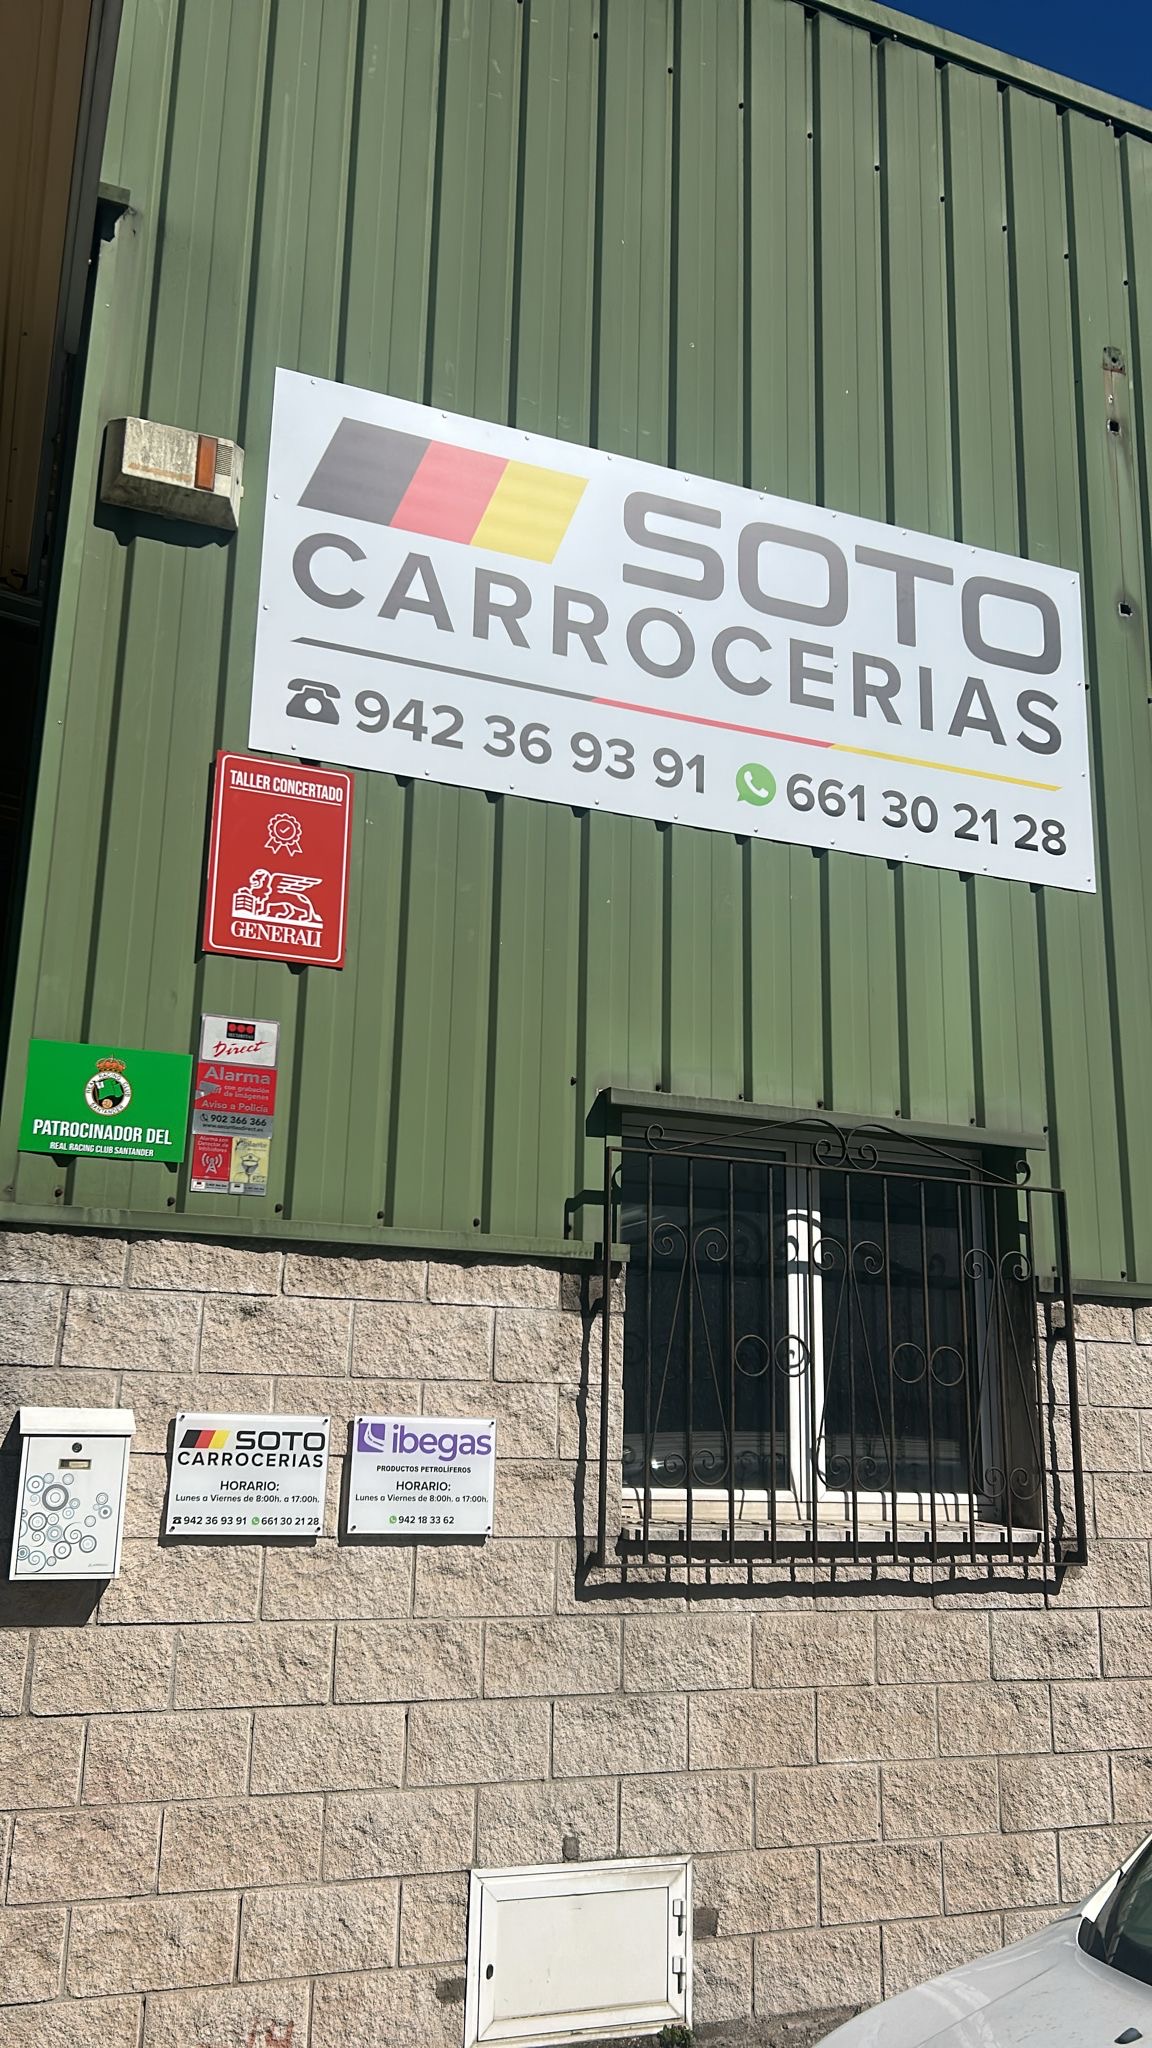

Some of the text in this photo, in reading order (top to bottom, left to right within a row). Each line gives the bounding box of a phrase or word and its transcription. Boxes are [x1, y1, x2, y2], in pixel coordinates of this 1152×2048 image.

[623, 491, 1063, 675] SOTO
[292, 532, 1063, 755] CARROCERIAS
[354, 690, 707, 794] 942 36 93 91
[230, 769, 343, 803] TALLER CONCERTADO
[786, 774, 1068, 855] 661 30 21 28
[231, 920, 323, 948] GENERALI
[213, 1040, 270, 1057] Direct
[204, 1066, 271, 1085] Alarma
[202, 1100, 227, 1109] Aviso
[211, 1114, 267, 1126] 902 366 366
[32, 1119, 172, 1145] PATROCINADOR DEL
[50, 1141, 154, 1157] REAL RACING CLUB SANTANDER
[235, 1430, 326, 1451] SOTO
[392, 1423, 492, 1462] ibegas
[177, 1452, 323, 1468] CARROCERIAS
[376, 1465, 472, 1473] PRODUCTOS PETROLÍFEROS
[220, 1481, 280, 1491] HORARIO:
[396, 1481, 451, 1491] HORARIO:
[175, 1494, 200, 1502] Lunes
[210, 1494, 241, 1502] Viernes
[256, 1495, 282, 1503] 8:00h.
[291, 1495, 320, 1503] 17:00h.
[355, 1494, 378, 1502] Lunes
[387, 1494, 416, 1502] Viernes
[418, 1494, 428, 1502] de
[429, 1495, 453, 1503] 8:00h.
[462, 1495, 489, 1503] 17:00h.
[183, 1516, 247, 1525] 942 36 93 91
[261, 1517, 320, 1525] 661 30 21 28
[398, 1516, 454, 1524] 942 18 33 62
